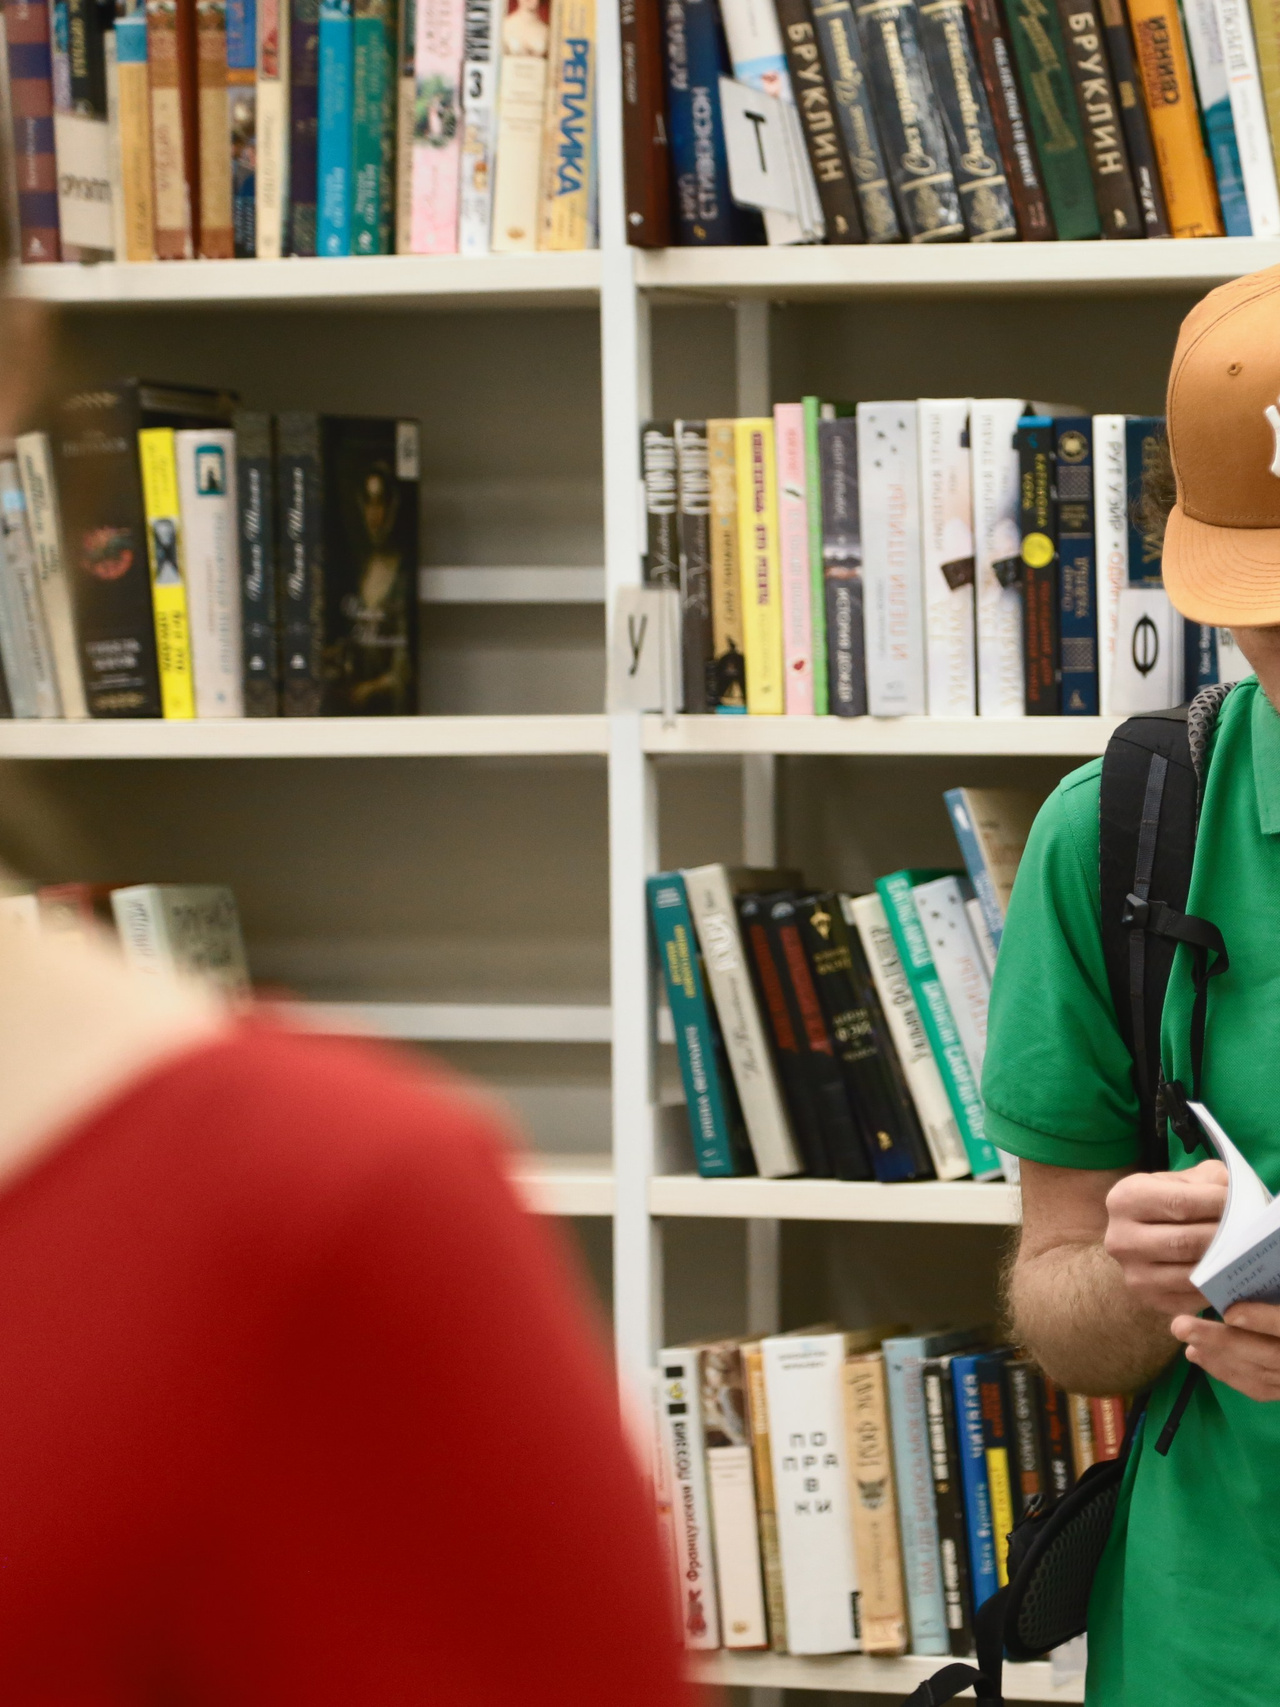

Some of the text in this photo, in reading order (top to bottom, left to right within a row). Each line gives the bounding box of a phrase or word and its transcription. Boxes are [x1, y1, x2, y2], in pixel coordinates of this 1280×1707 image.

[1067, 11, 1124, 176] БРУКЛИН
[1152, 14, 1180, 105] СВИНЕЙ
[557, 38, 590, 197] РЕПЛИКА
[742, 109, 768, 175] Т
[786, 21, 846, 183] БРУКЛИН
[690, 86, 719, 221] СТИВЕНСОН
[1034, 453, 1048, 528] КАТРИОНА
[1109, 440, 1124, 475] РУТ
[1109, 481, 1126, 532] УЭЙР
[887, 483, 908, 660] И ПЕЛИ ПТИЦЫ
[628, 613, 648, 677] У
[837, 587, 852, 704] ИСТОРИЯ ДОЖДЯ
[1131, 613, 1160, 679] Ф
[789, 1431, 828, 1449] ПО
[962, 1373, 984, 1458] ЧИТАЛКА
[782, 1453, 840, 1470] ПРА
[803, 1477, 820, 1494] В
[676, 1484, 704, 1582] Французская
